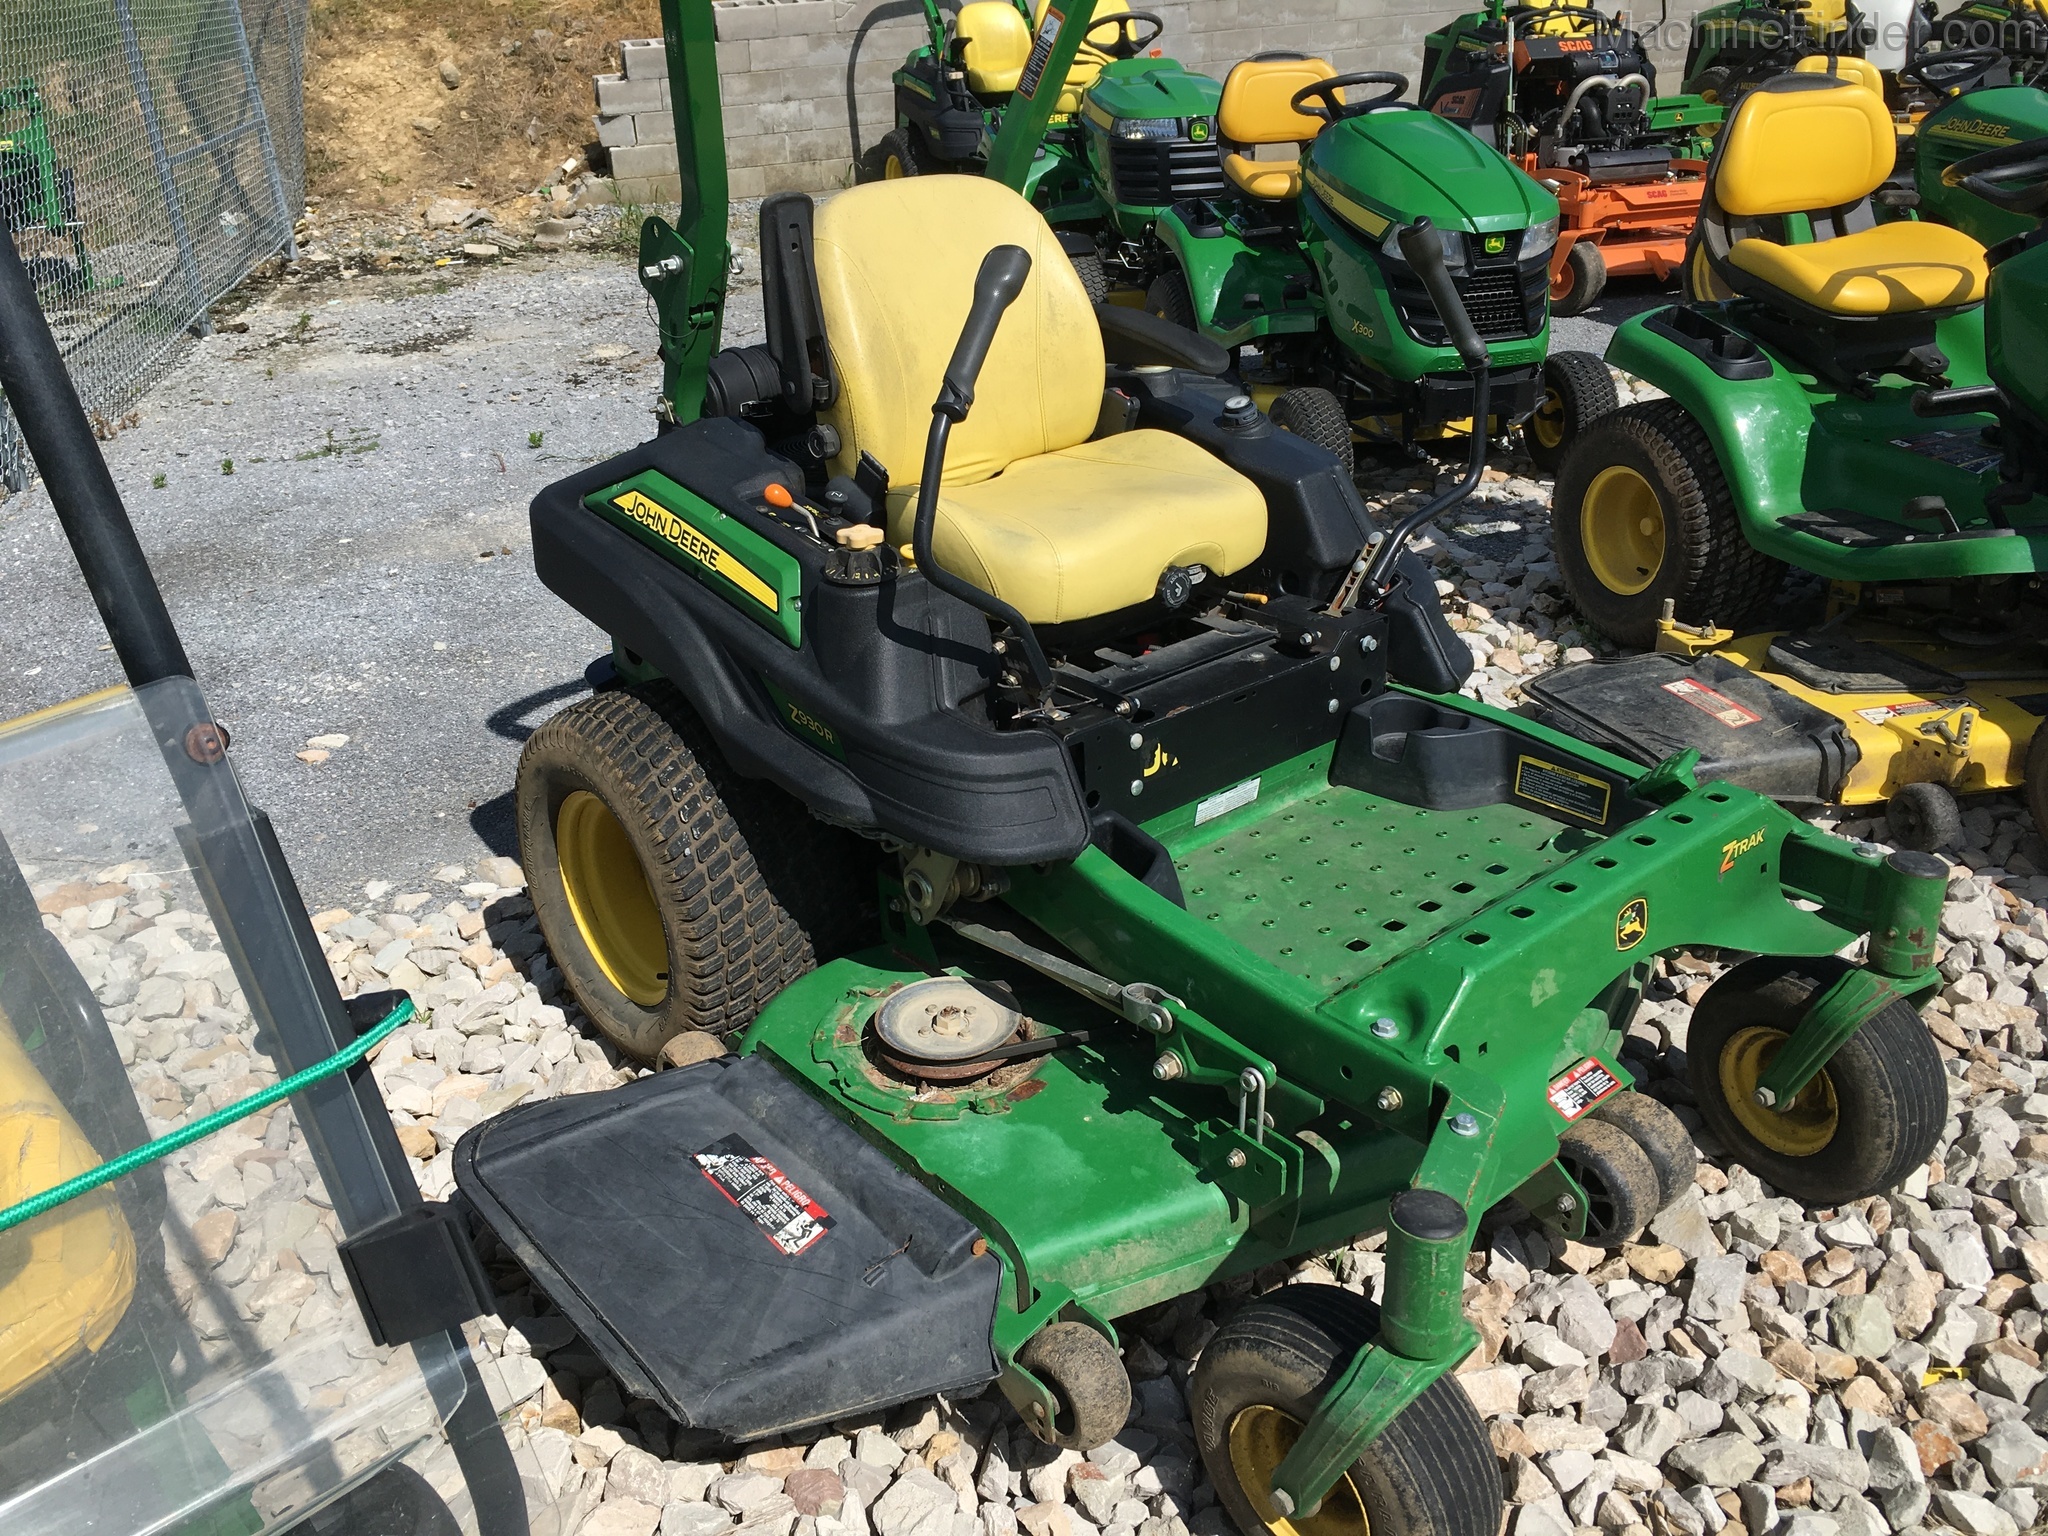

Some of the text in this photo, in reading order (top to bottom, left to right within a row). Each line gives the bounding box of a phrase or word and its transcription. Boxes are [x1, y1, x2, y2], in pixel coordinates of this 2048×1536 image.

[1558, 39, 1593, 52] SCAG
[1941, 116, 2011, 138] JOHN DEERE
[1646, 189, 1668, 199] SCAG
[1351, 318, 1375, 339] X300
[626, 495, 720, 569] JOHN DEERE
[787, 702, 835, 745] Z930R
[780, 1179, 811, 1207] PELIGRO
